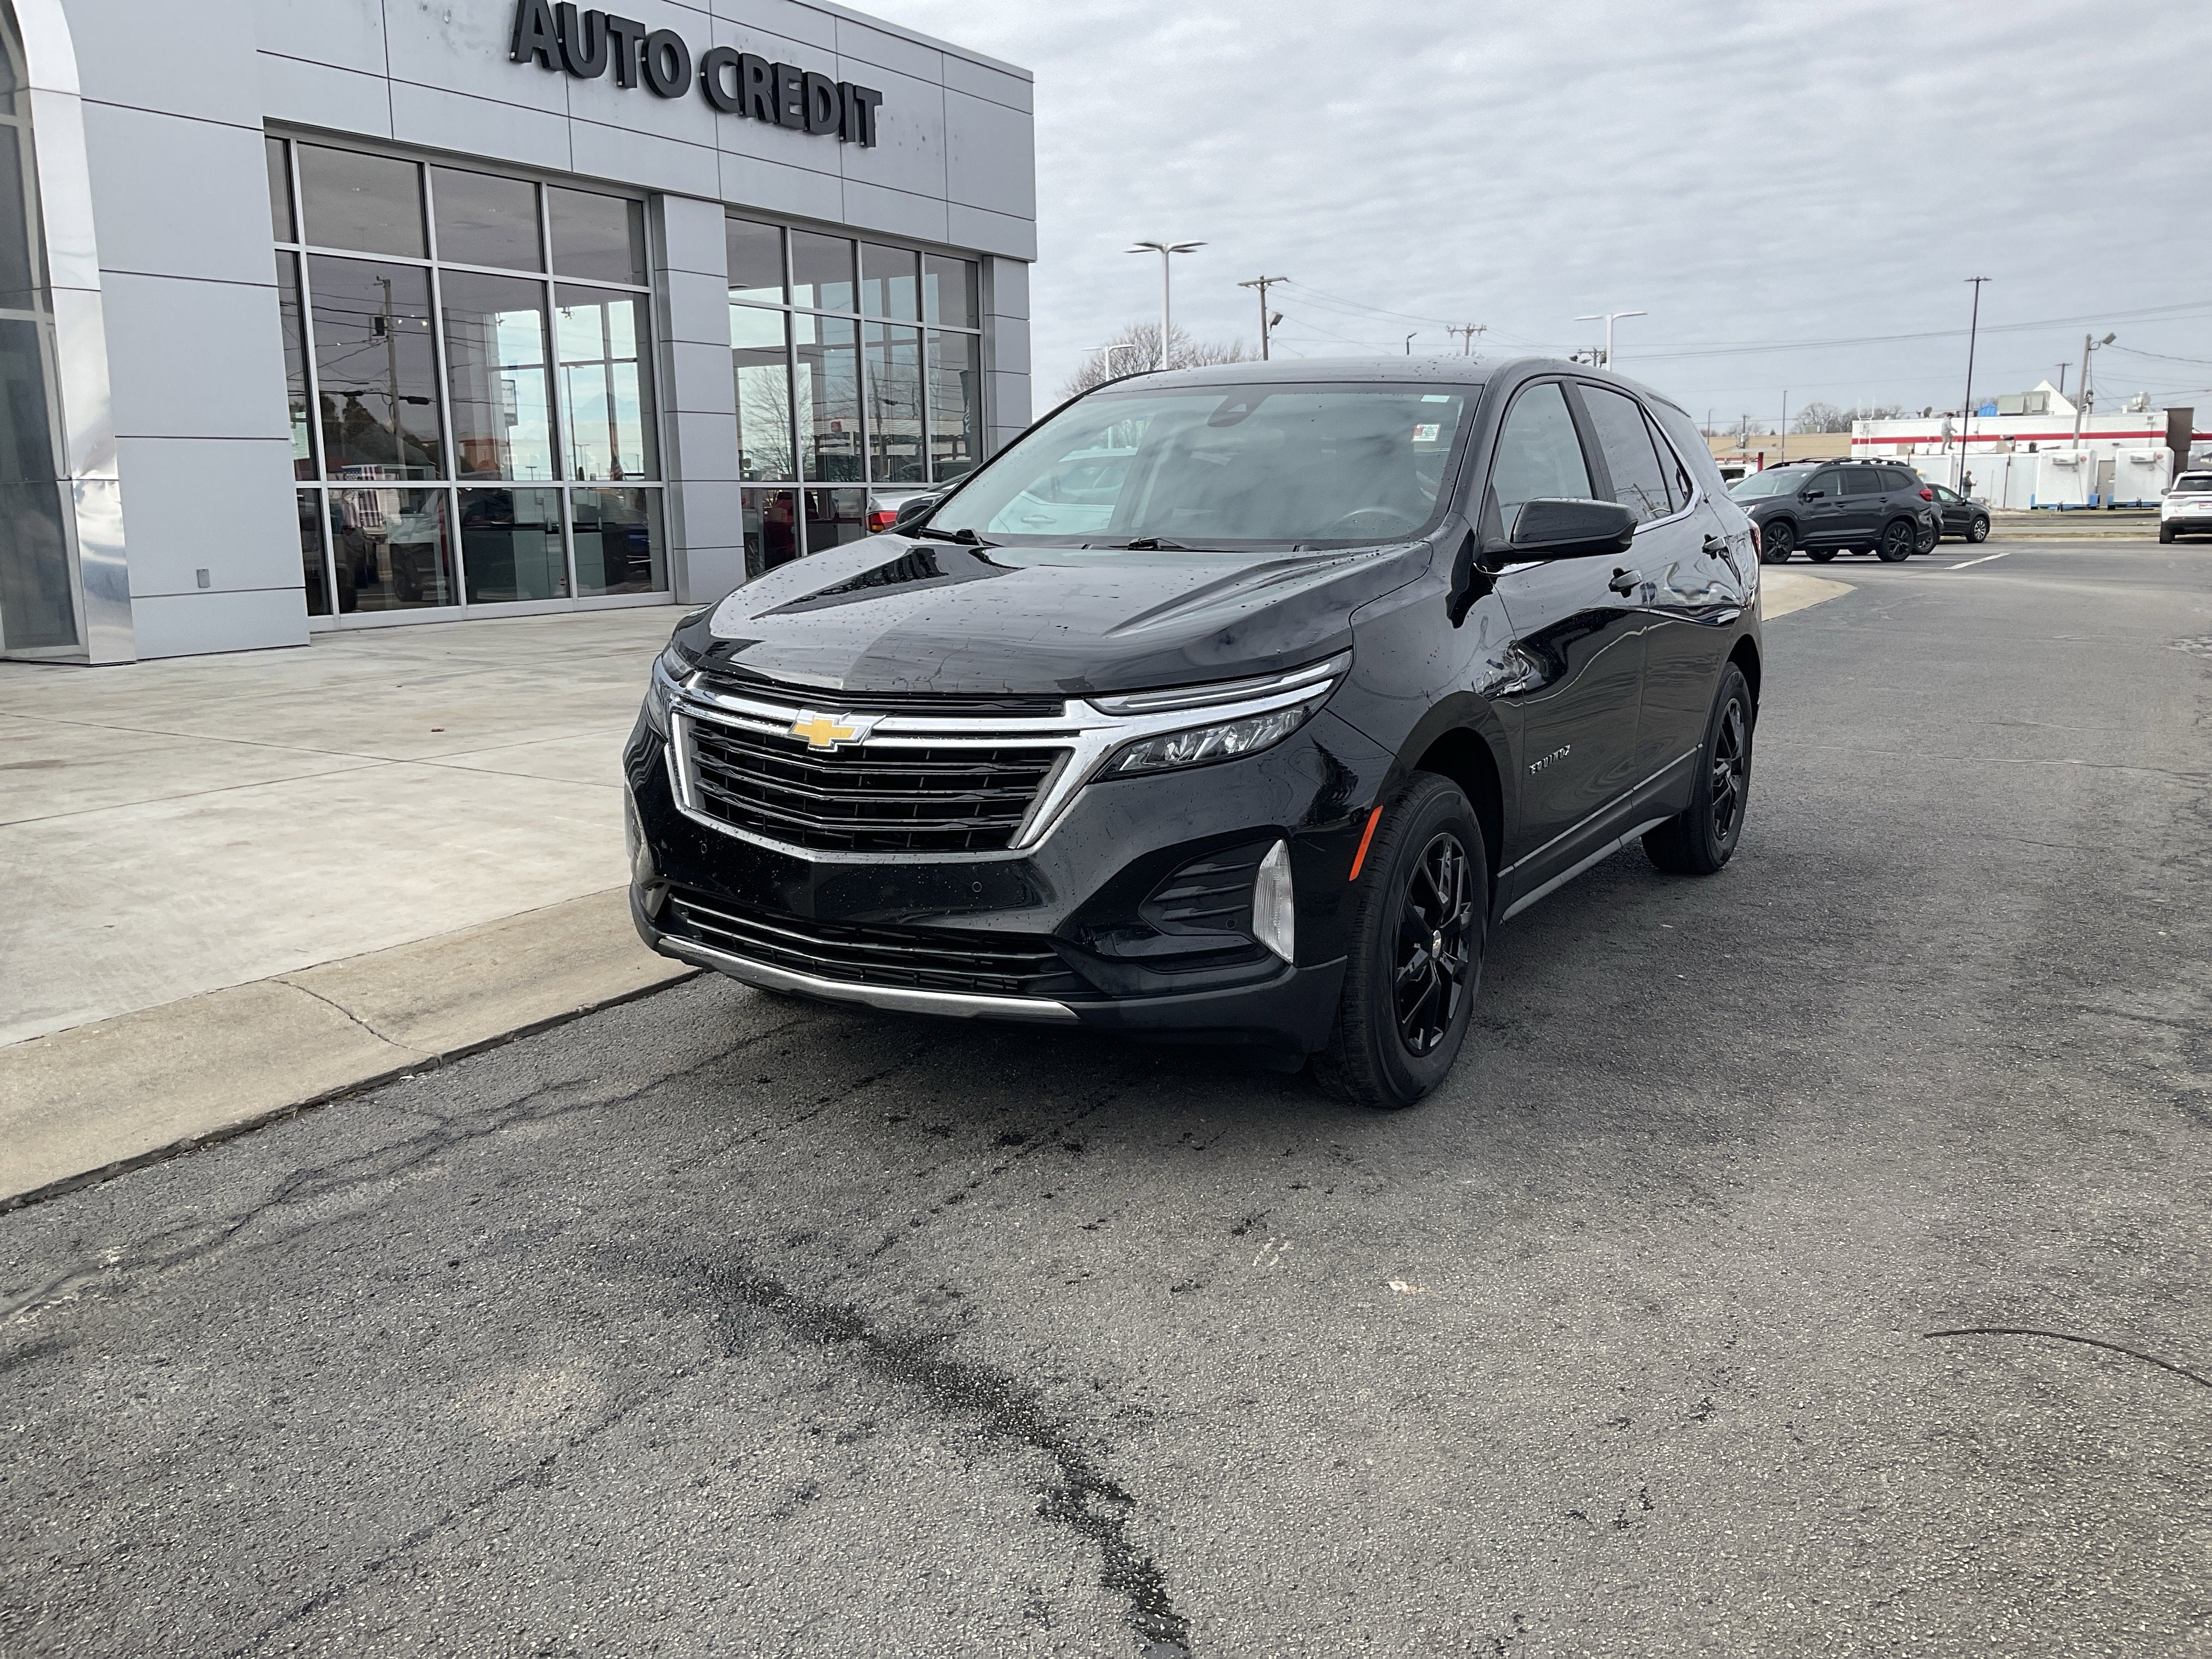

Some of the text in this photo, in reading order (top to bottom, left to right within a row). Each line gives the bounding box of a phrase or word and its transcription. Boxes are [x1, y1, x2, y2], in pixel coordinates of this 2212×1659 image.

[510, 0, 883, 148] AUTO CREDIT
[1529, 744, 1571, 776] EQUINOX
